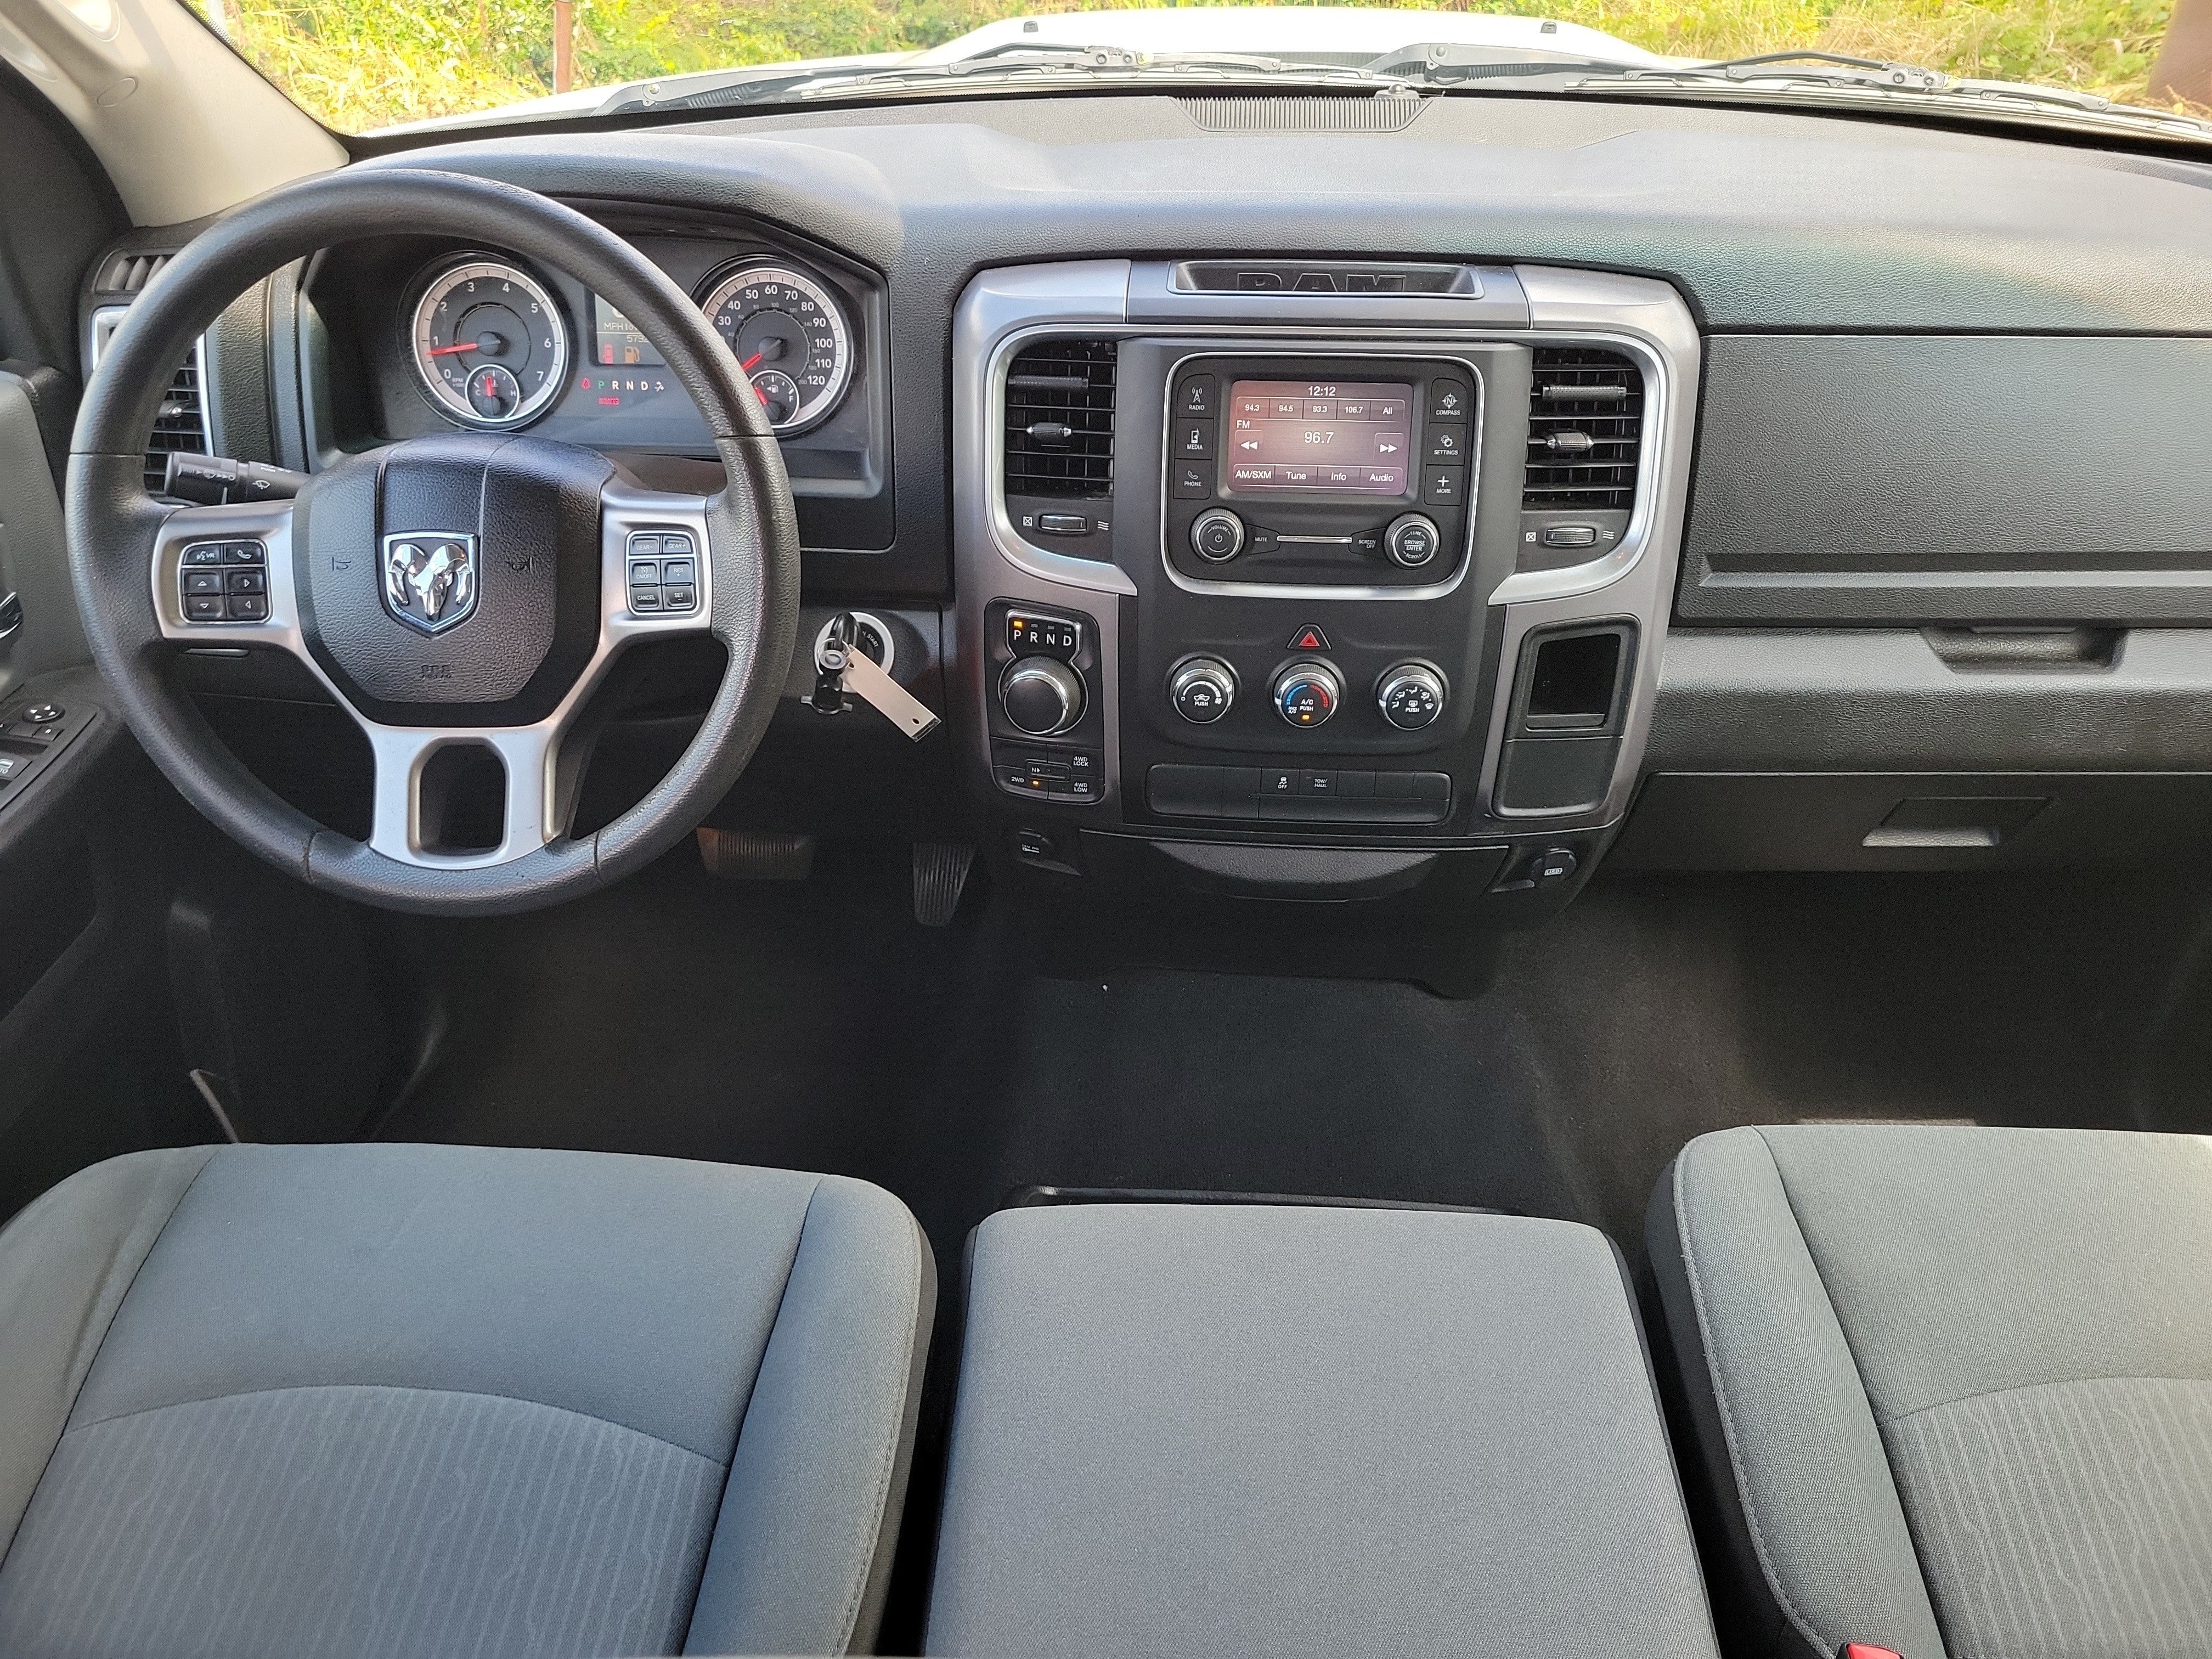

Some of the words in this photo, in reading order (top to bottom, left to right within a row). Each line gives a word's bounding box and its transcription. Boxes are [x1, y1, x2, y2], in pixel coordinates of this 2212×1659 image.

[468, 283, 475, 292] 3
[503, 283, 510, 292] 4
[765, 285, 778, 295] 60
[746, 290, 758, 299] 50
[785, 290, 798, 300] 70
[441, 302, 447, 311] 2
[531, 303, 538, 313] 5
[727, 301, 741, 310] 40
[801, 302, 814, 311] 80
[718, 316, 731, 325] 30
[812, 318, 826, 327] 90
[433, 336, 438, 345] 1
[544, 338, 551, 348] 6
[815, 338, 833, 348] 100
[815, 359, 832, 368] 110
[444, 369, 451, 379] 0
[537, 371, 544, 381] 7
[807, 375, 825, 385] 120
[599, 381, 604, 390] P
[612, 381, 619, 390] R
[627, 381, 634, 390] N
[641, 381, 648, 391] D
[1308, 386, 1336, 397] 12:12
[1383, 407, 1393, 415] All
[1237, 420, 1250, 428] FM
[1304, 431, 1334, 444] 96.7
[1235, 470, 1272, 479] AM/SXM
[1286, 471, 1307, 480] Tune
[1331, 472, 1347, 481] Info
[1369, 473, 1394, 482] Audio
[867, 634, 879, 647] START
[1014, 629, 1022, 640] P
[1030, 631, 1038, 643] R
[1046, 633, 1055, 645] N
[1063, 635, 1072, 646] D
